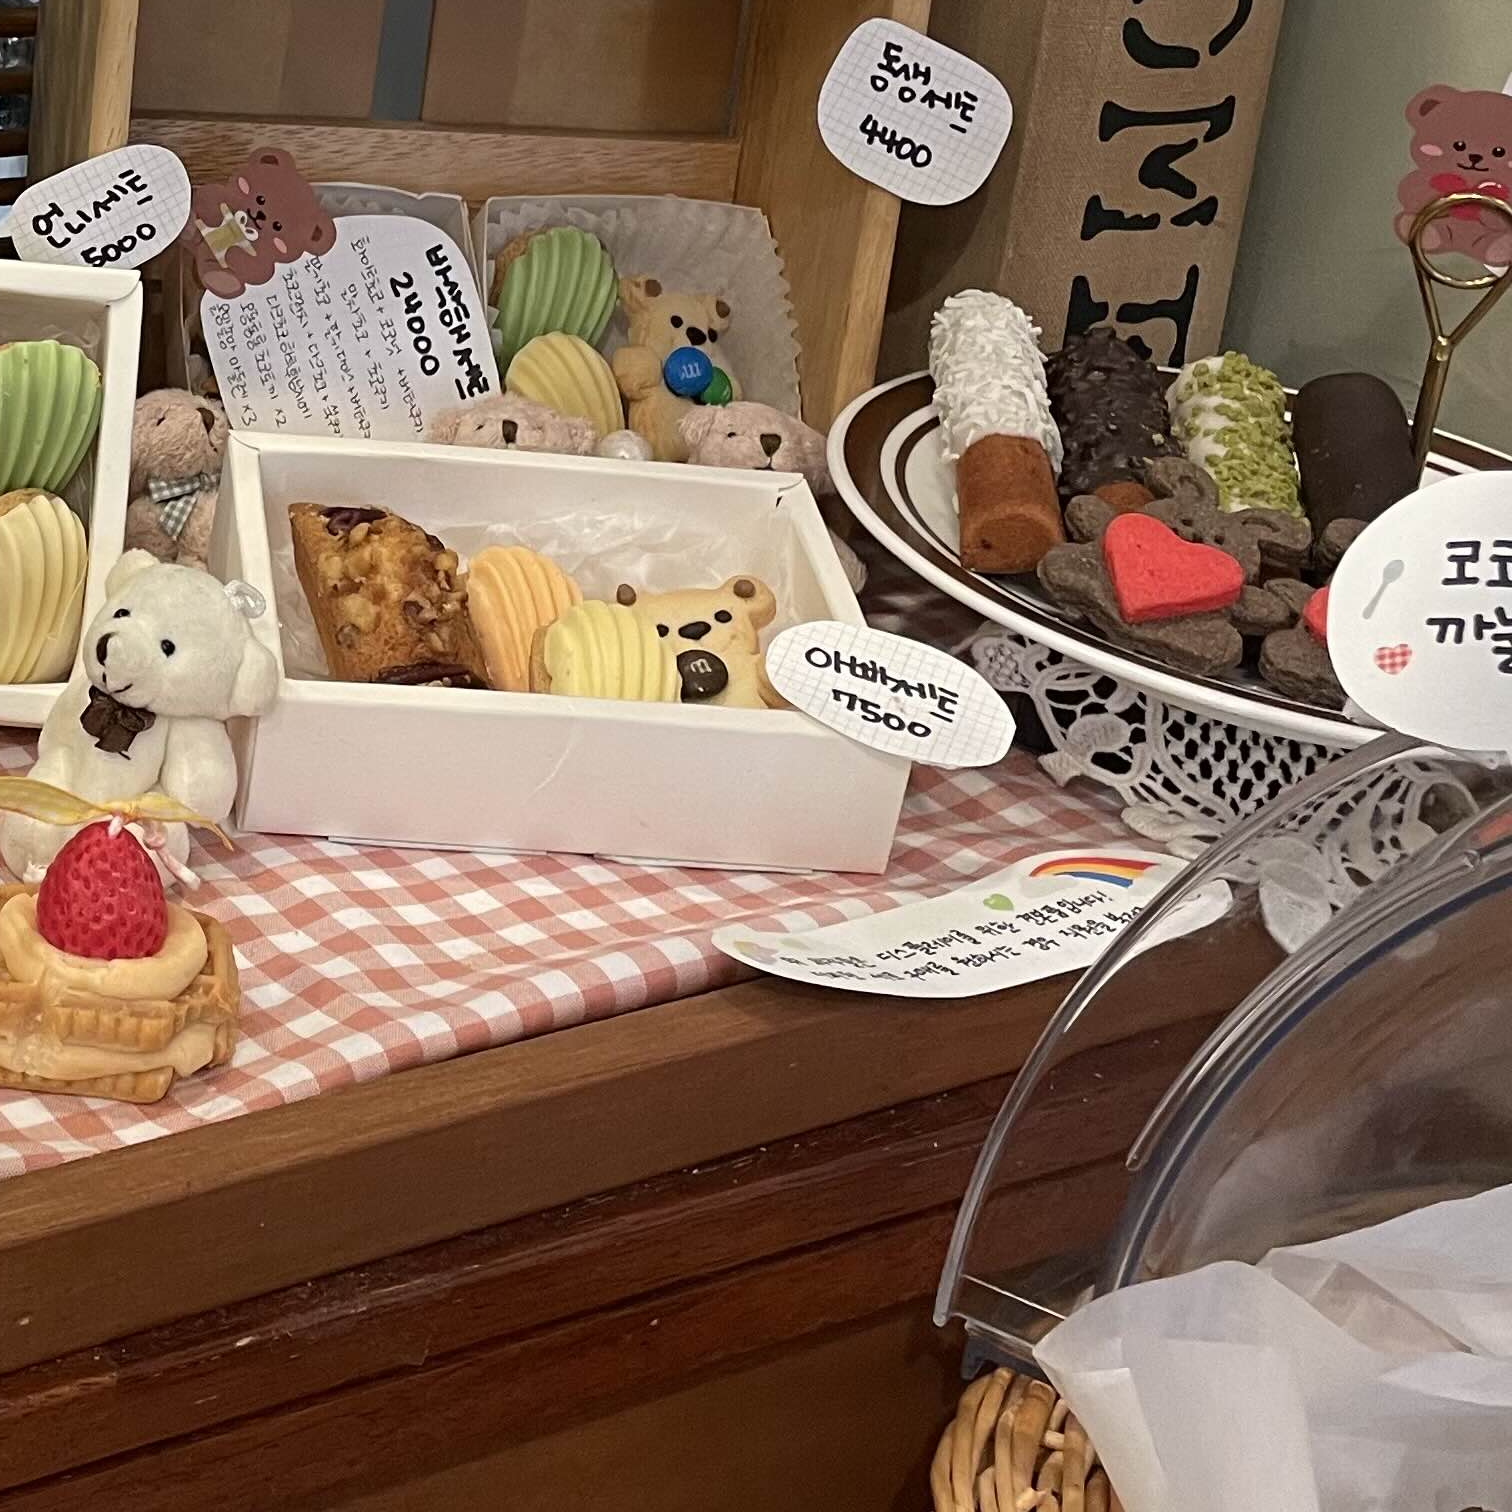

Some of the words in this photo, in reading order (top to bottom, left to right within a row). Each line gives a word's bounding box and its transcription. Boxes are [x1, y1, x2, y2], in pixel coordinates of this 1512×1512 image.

[870, 41, 980, 134] 동생세트
[859, 114, 934, 169] 4400
[32, 169, 154, 249] 언니세트
[80, 223, 156, 268] 5000
[390, 271, 441, 377] 24000
[804, 647, 960, 723] 아빠세트
[831, 688, 931, 738] 7500
